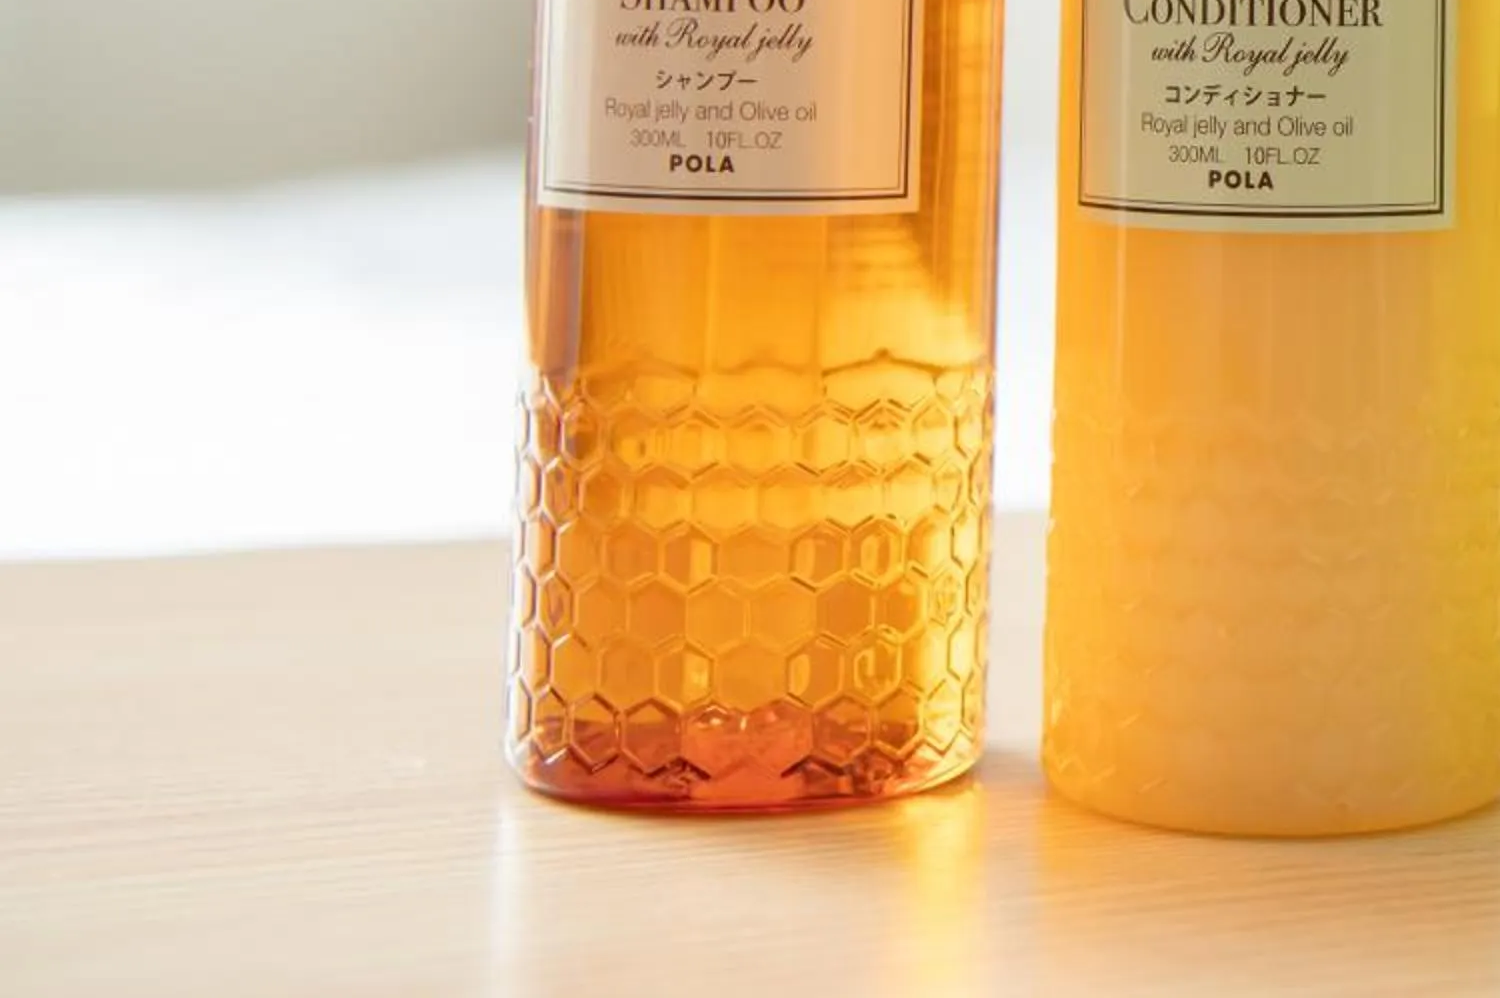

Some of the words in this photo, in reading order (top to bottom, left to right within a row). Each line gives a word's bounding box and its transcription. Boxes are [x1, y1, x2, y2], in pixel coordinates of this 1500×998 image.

[615, 23, 660, 47] with
[665, 17, 757, 61] Royal
[746, 25, 813, 62] jelly
[1151, 35, 1198, 63] with
[1201, 32, 1293, 75] Royal
[1283, 37, 1349, 76] jelly
[656, 70, 758, 90] シャンプー
[1165, 84, 1326, 106] コンディショナー
[605, 99, 651, 120] Royal
[654, 102, 690, 123] jelly
[695, 102, 732, 120] and
[739, 102, 788, 121] Olive
[795, 102, 816, 121] oil
[1142, 112, 1187, 136] Royal
[1192, 114, 1227, 139] jelly
[1234, 115, 1271, 135] and
[1278, 116, 1326, 136] Olive
[1333, 116, 1353, 136] oil
[630, 129, 686, 148] 300ML
[670, 154, 735, 173] POLA
[1168, 145, 1223, 163] 300ML
[1208, 170, 1274, 189] POLA
